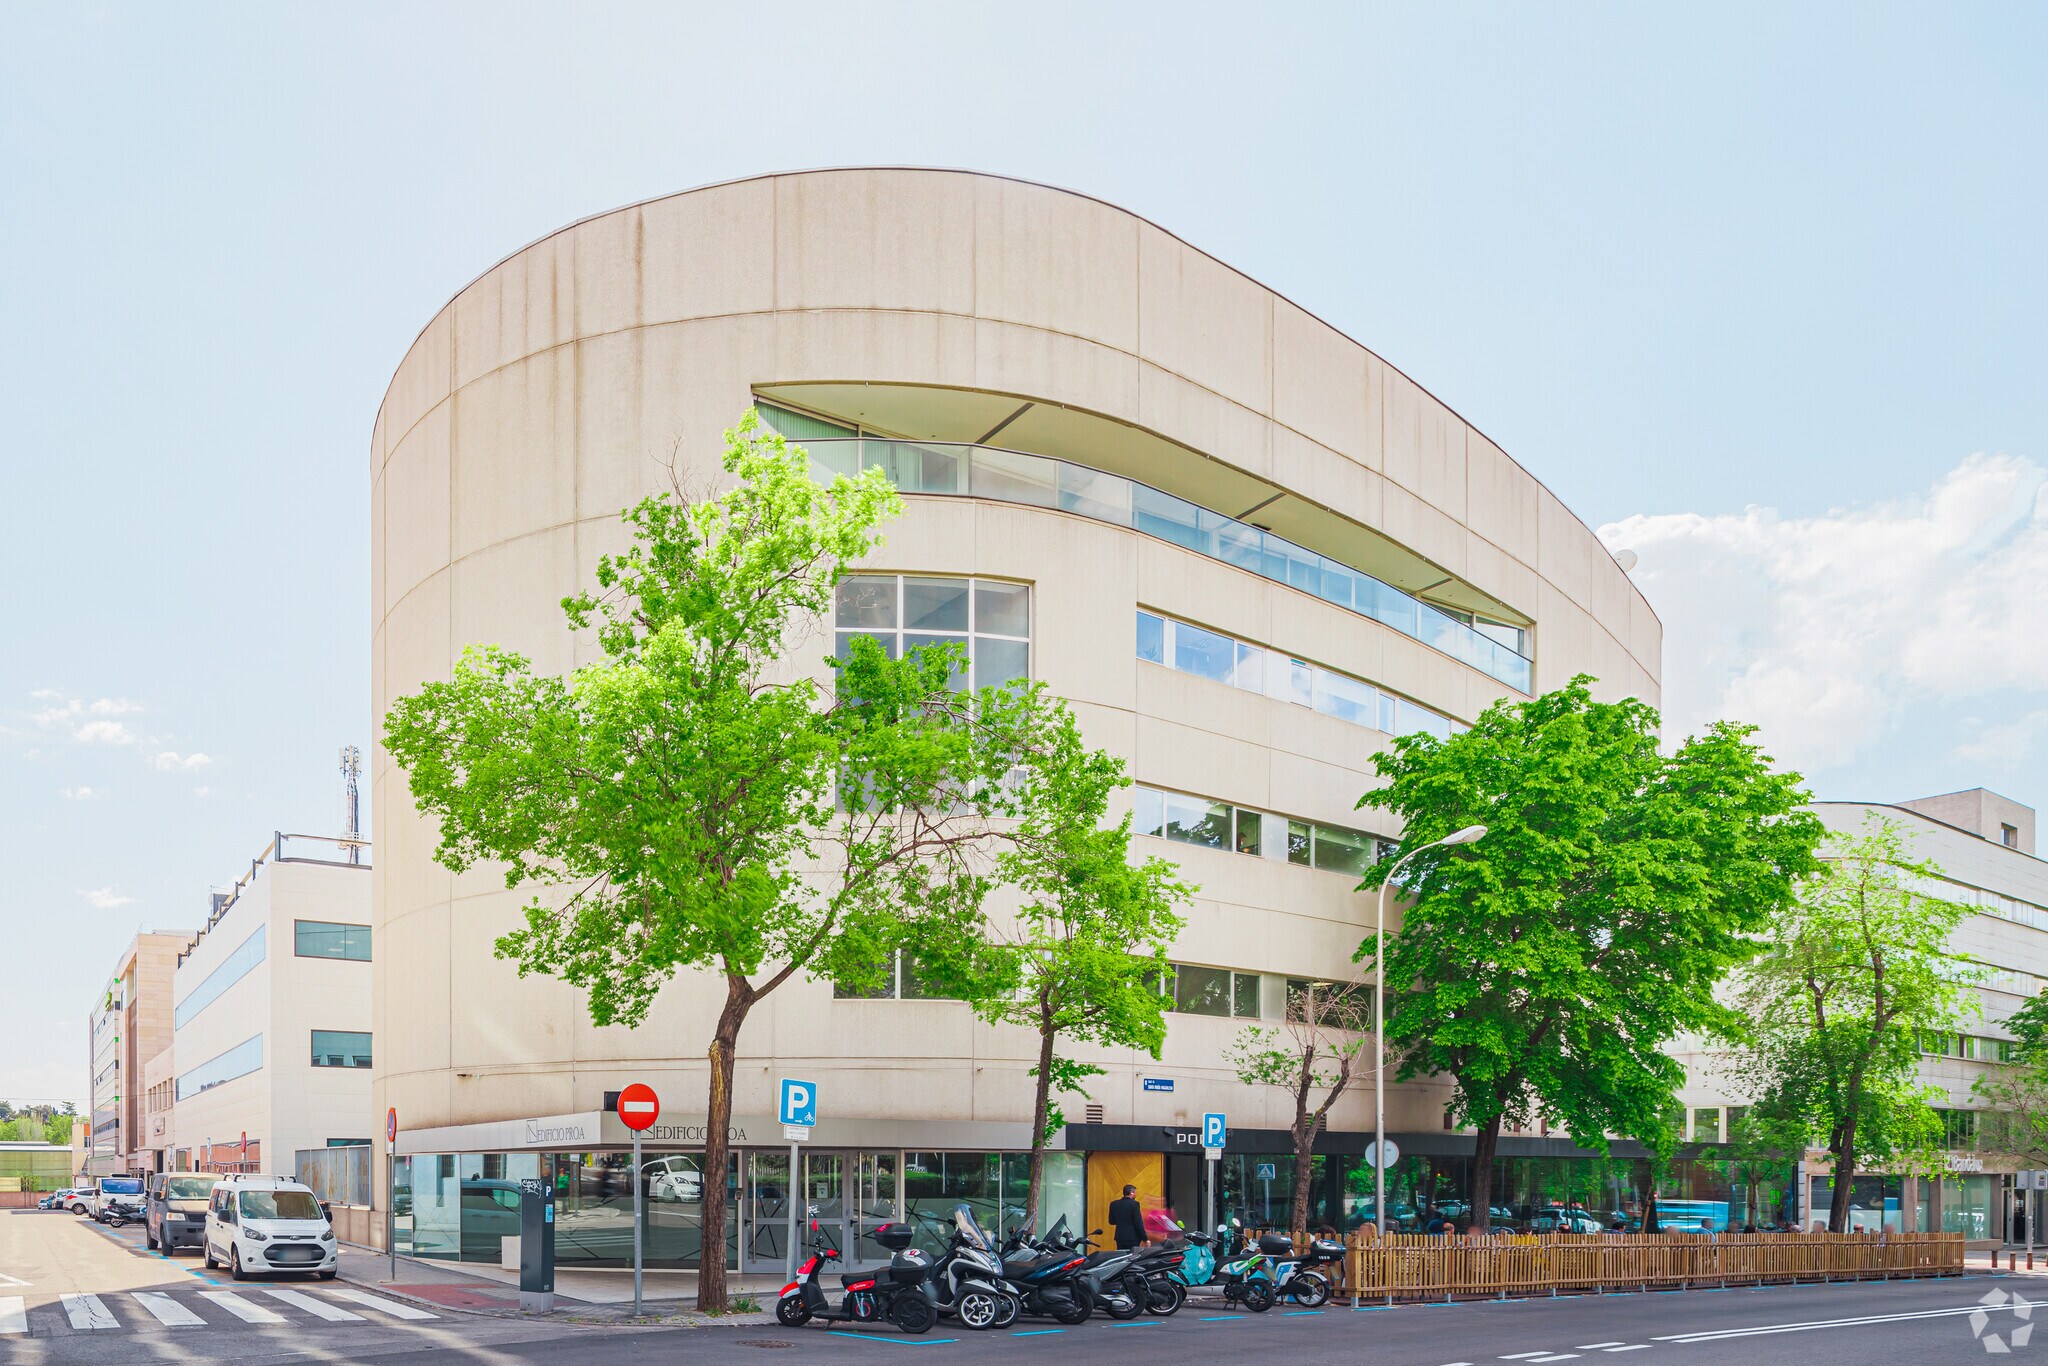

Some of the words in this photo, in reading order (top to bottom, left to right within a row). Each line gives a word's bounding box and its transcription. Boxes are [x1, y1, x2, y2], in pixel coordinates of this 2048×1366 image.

[787, 1084, 809, 1120] P
[537, 1127, 565, 1142] EDIFICIO
[565, 1126, 585, 1141] PROA
[728, 1127, 747, 1141] OA
[1208, 1117, 1222, 1144] P
[545, 1186, 552, 1197] P
